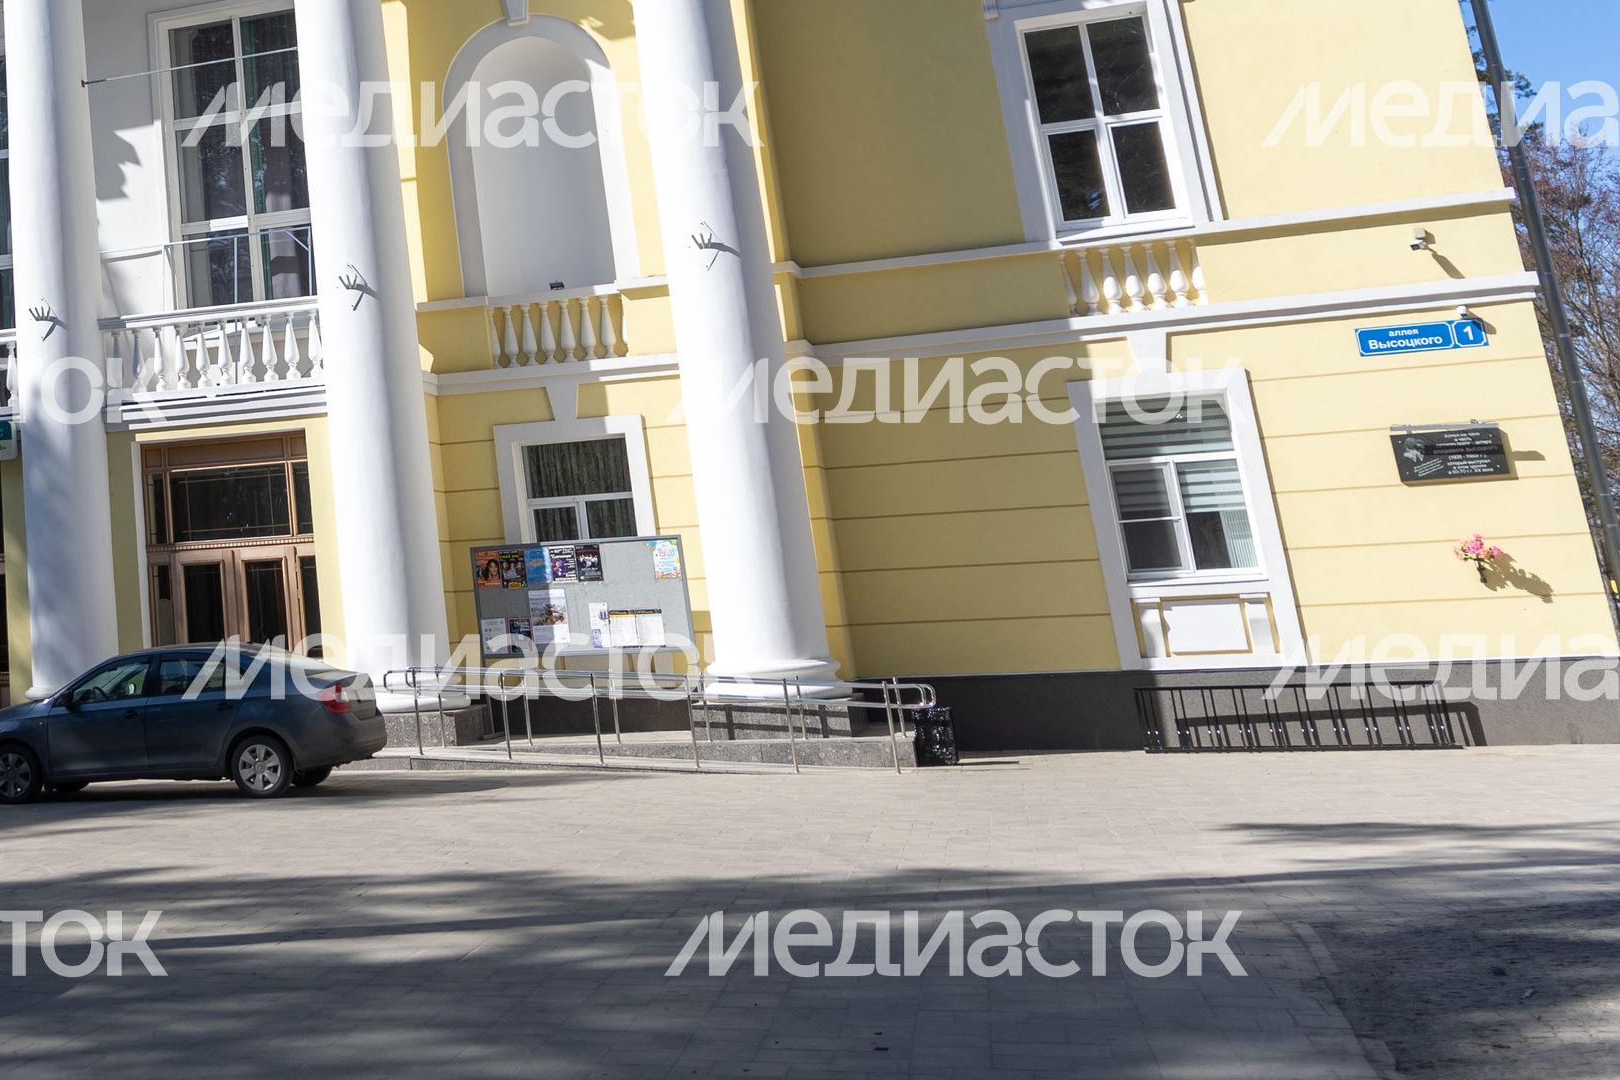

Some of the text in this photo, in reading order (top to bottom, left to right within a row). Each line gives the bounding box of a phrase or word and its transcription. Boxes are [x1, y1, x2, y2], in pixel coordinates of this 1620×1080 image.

[1388, 328, 1419, 337] аллея
[1463, 325, 1474, 341] 1
[1368, 336, 1443, 350] Высоцкого
